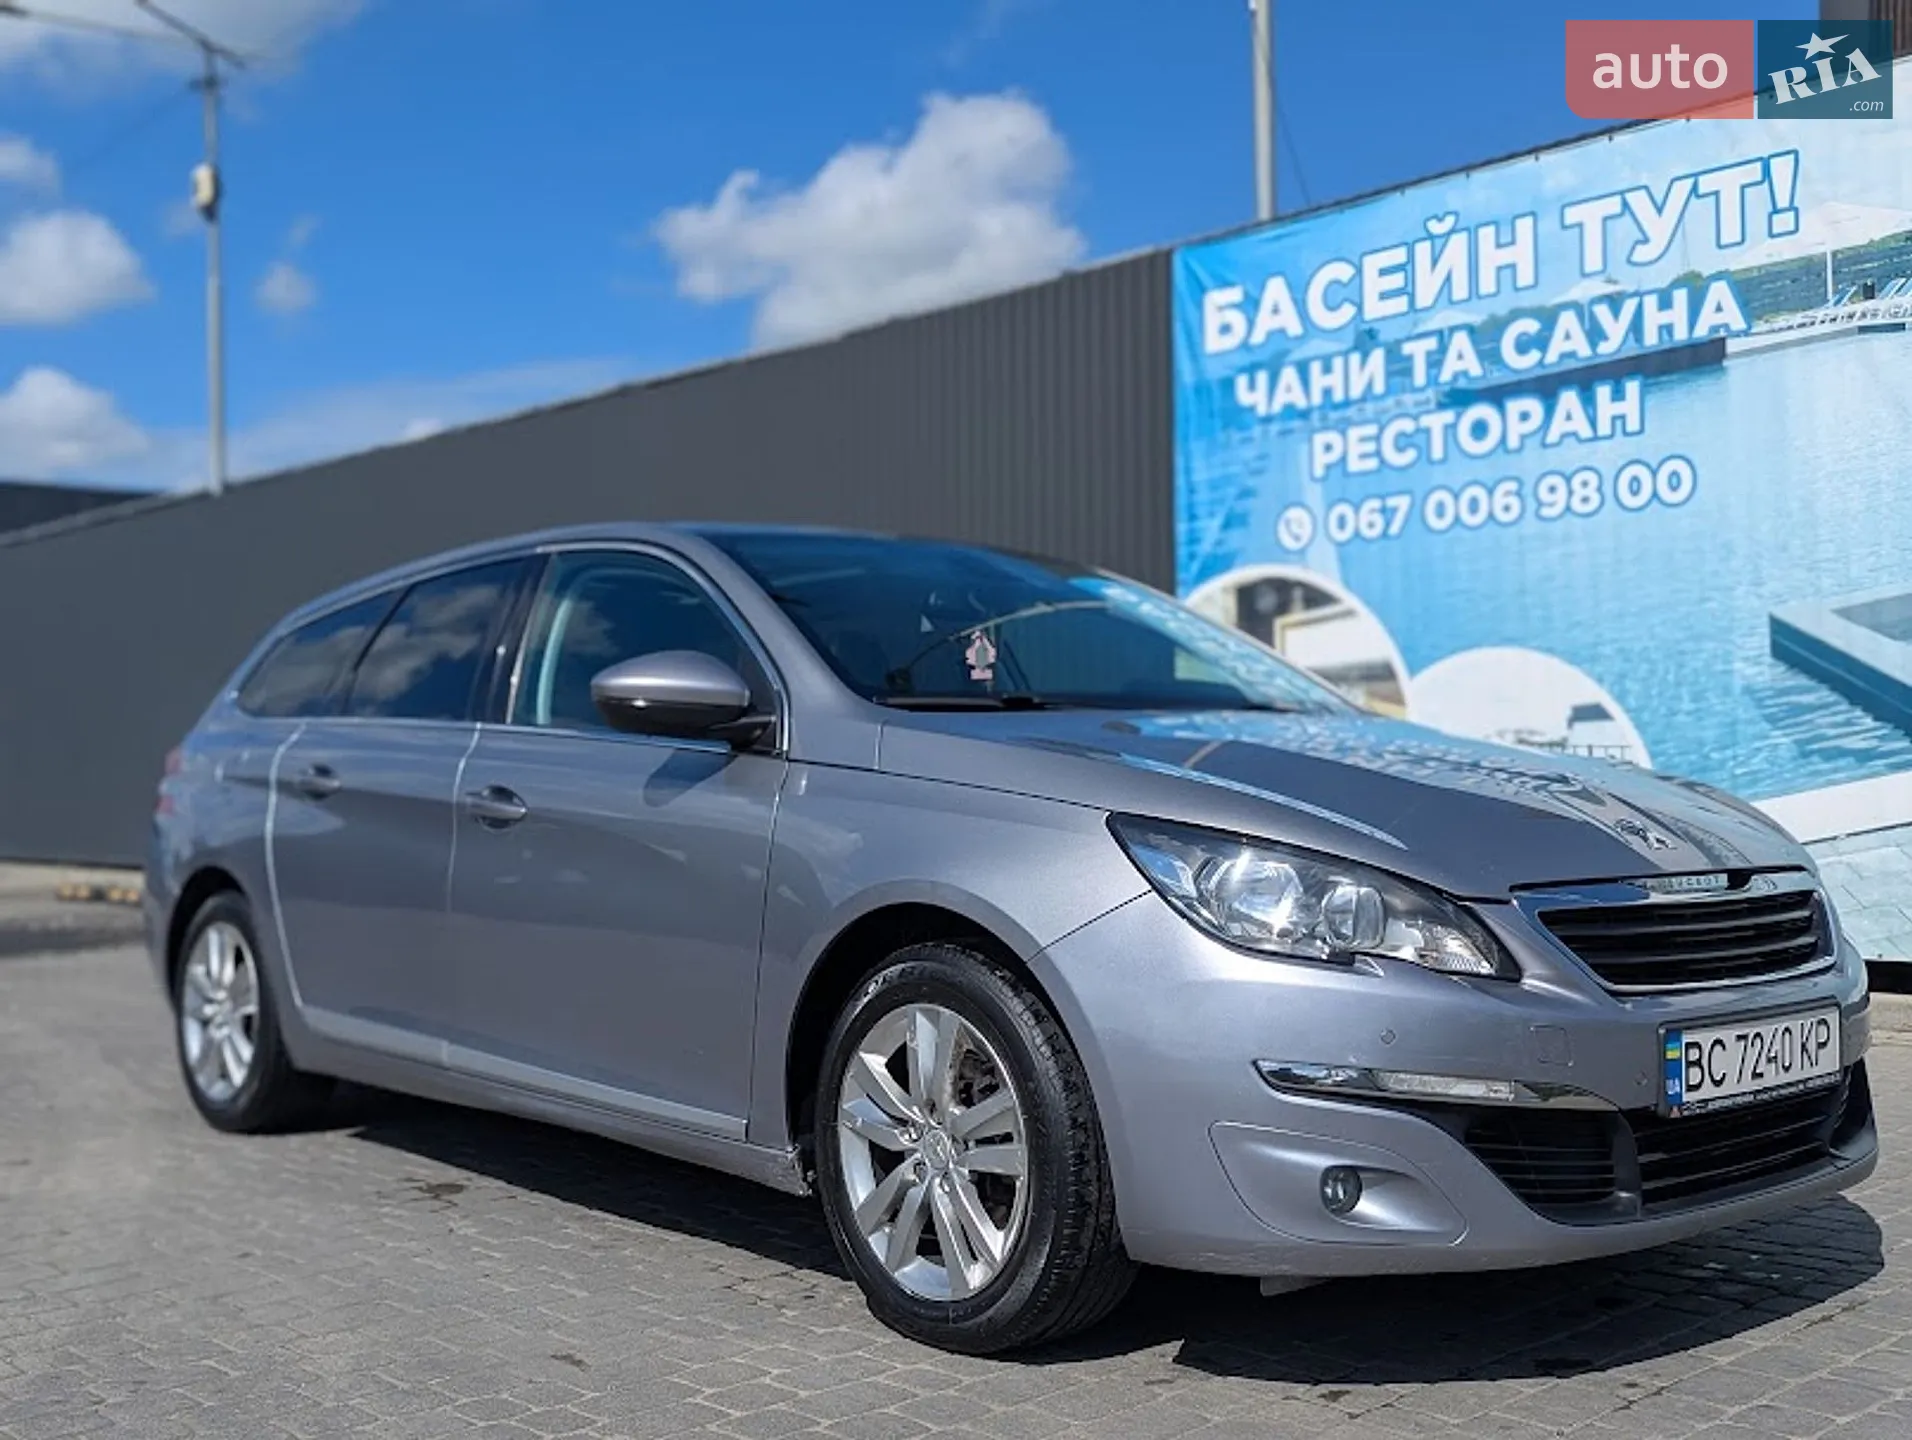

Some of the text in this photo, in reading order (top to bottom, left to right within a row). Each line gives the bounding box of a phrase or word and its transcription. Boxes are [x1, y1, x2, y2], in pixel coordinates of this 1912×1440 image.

[1202, 149, 1799, 355] БАСЕЙН ТУТ!
[1235, 280, 1749, 417] ЧАНИ ТА САУНА
[1310, 379, 1644, 480] РЕСТОРАН
[1326, 455, 1697, 543] 067 006 98 00
[1684, 1016, 1831, 1093] BC 7240 KP
